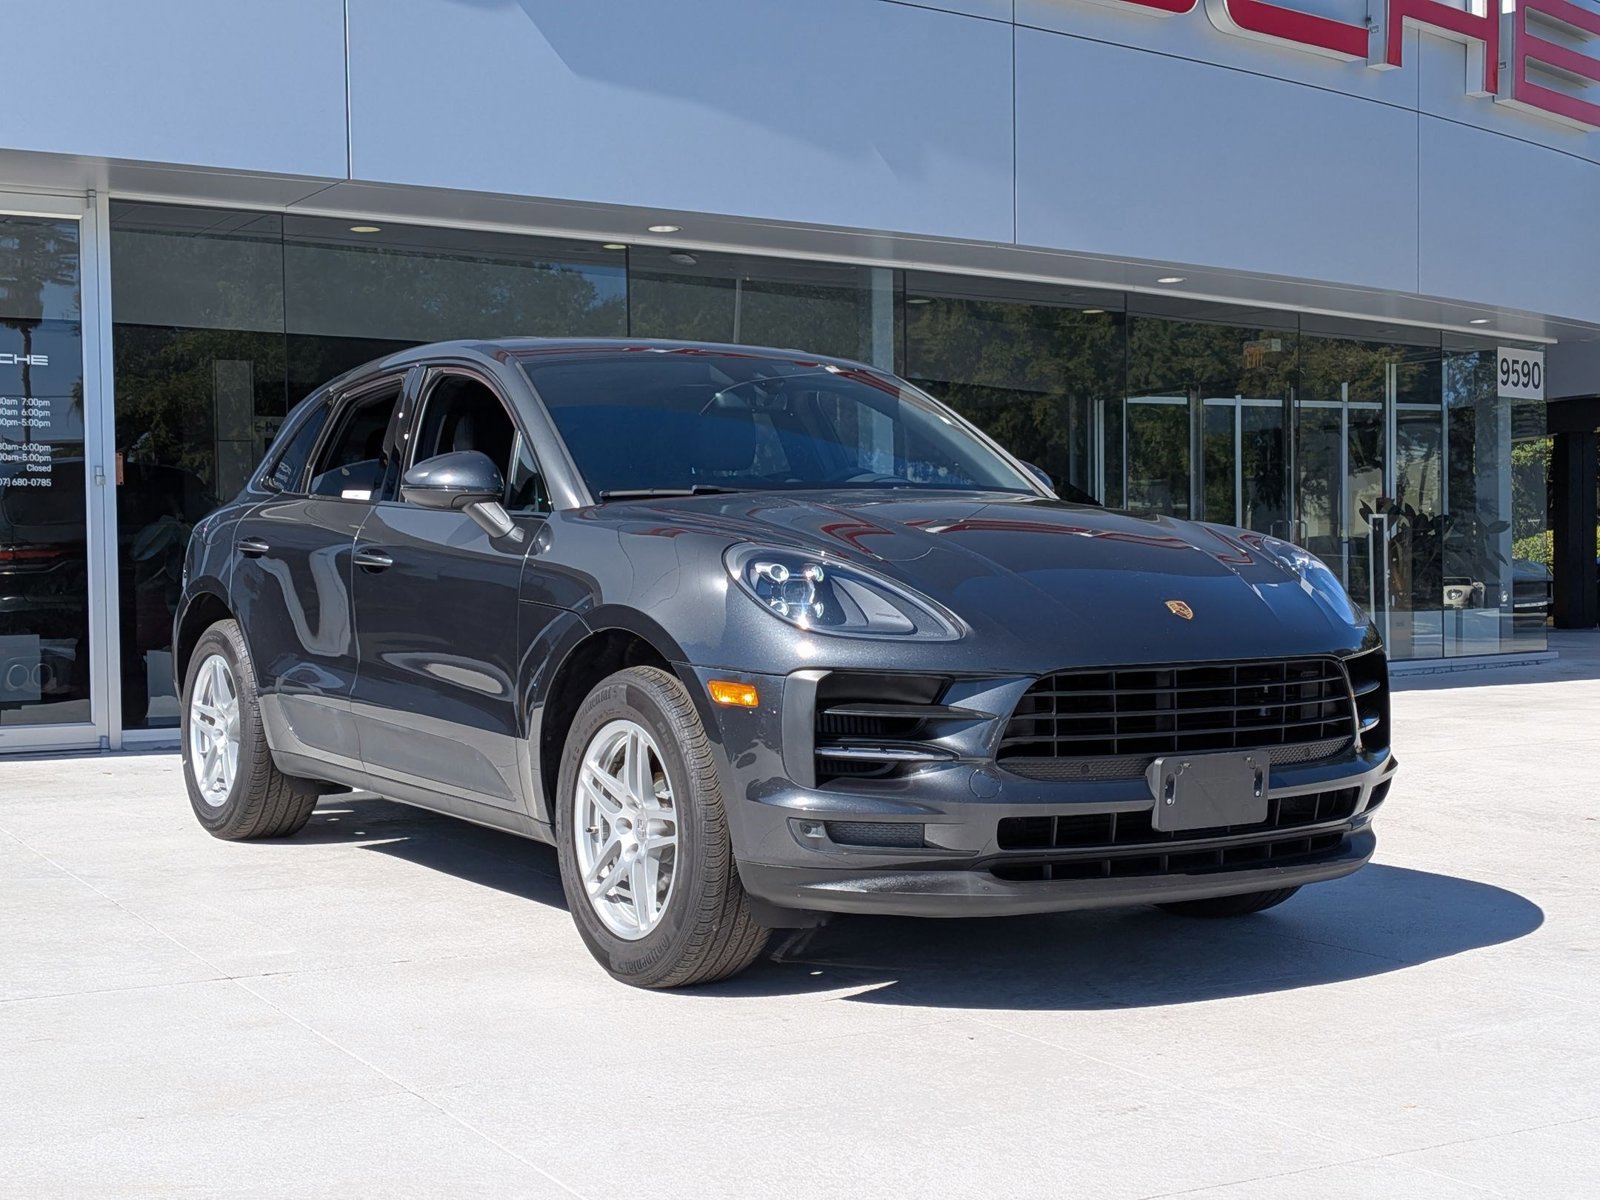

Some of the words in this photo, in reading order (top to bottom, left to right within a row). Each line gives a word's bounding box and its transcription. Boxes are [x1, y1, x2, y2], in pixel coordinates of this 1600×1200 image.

[1090, 0, 1600, 129] HE
[1500, 358, 1541, 389] 9590
[21, 397, 51, 407] 7:00pm
[21, 408, 51, 418] 6:00pm
[26, 464, 52, 473] Closed
[12, 478, 52, 487] 680-0785
